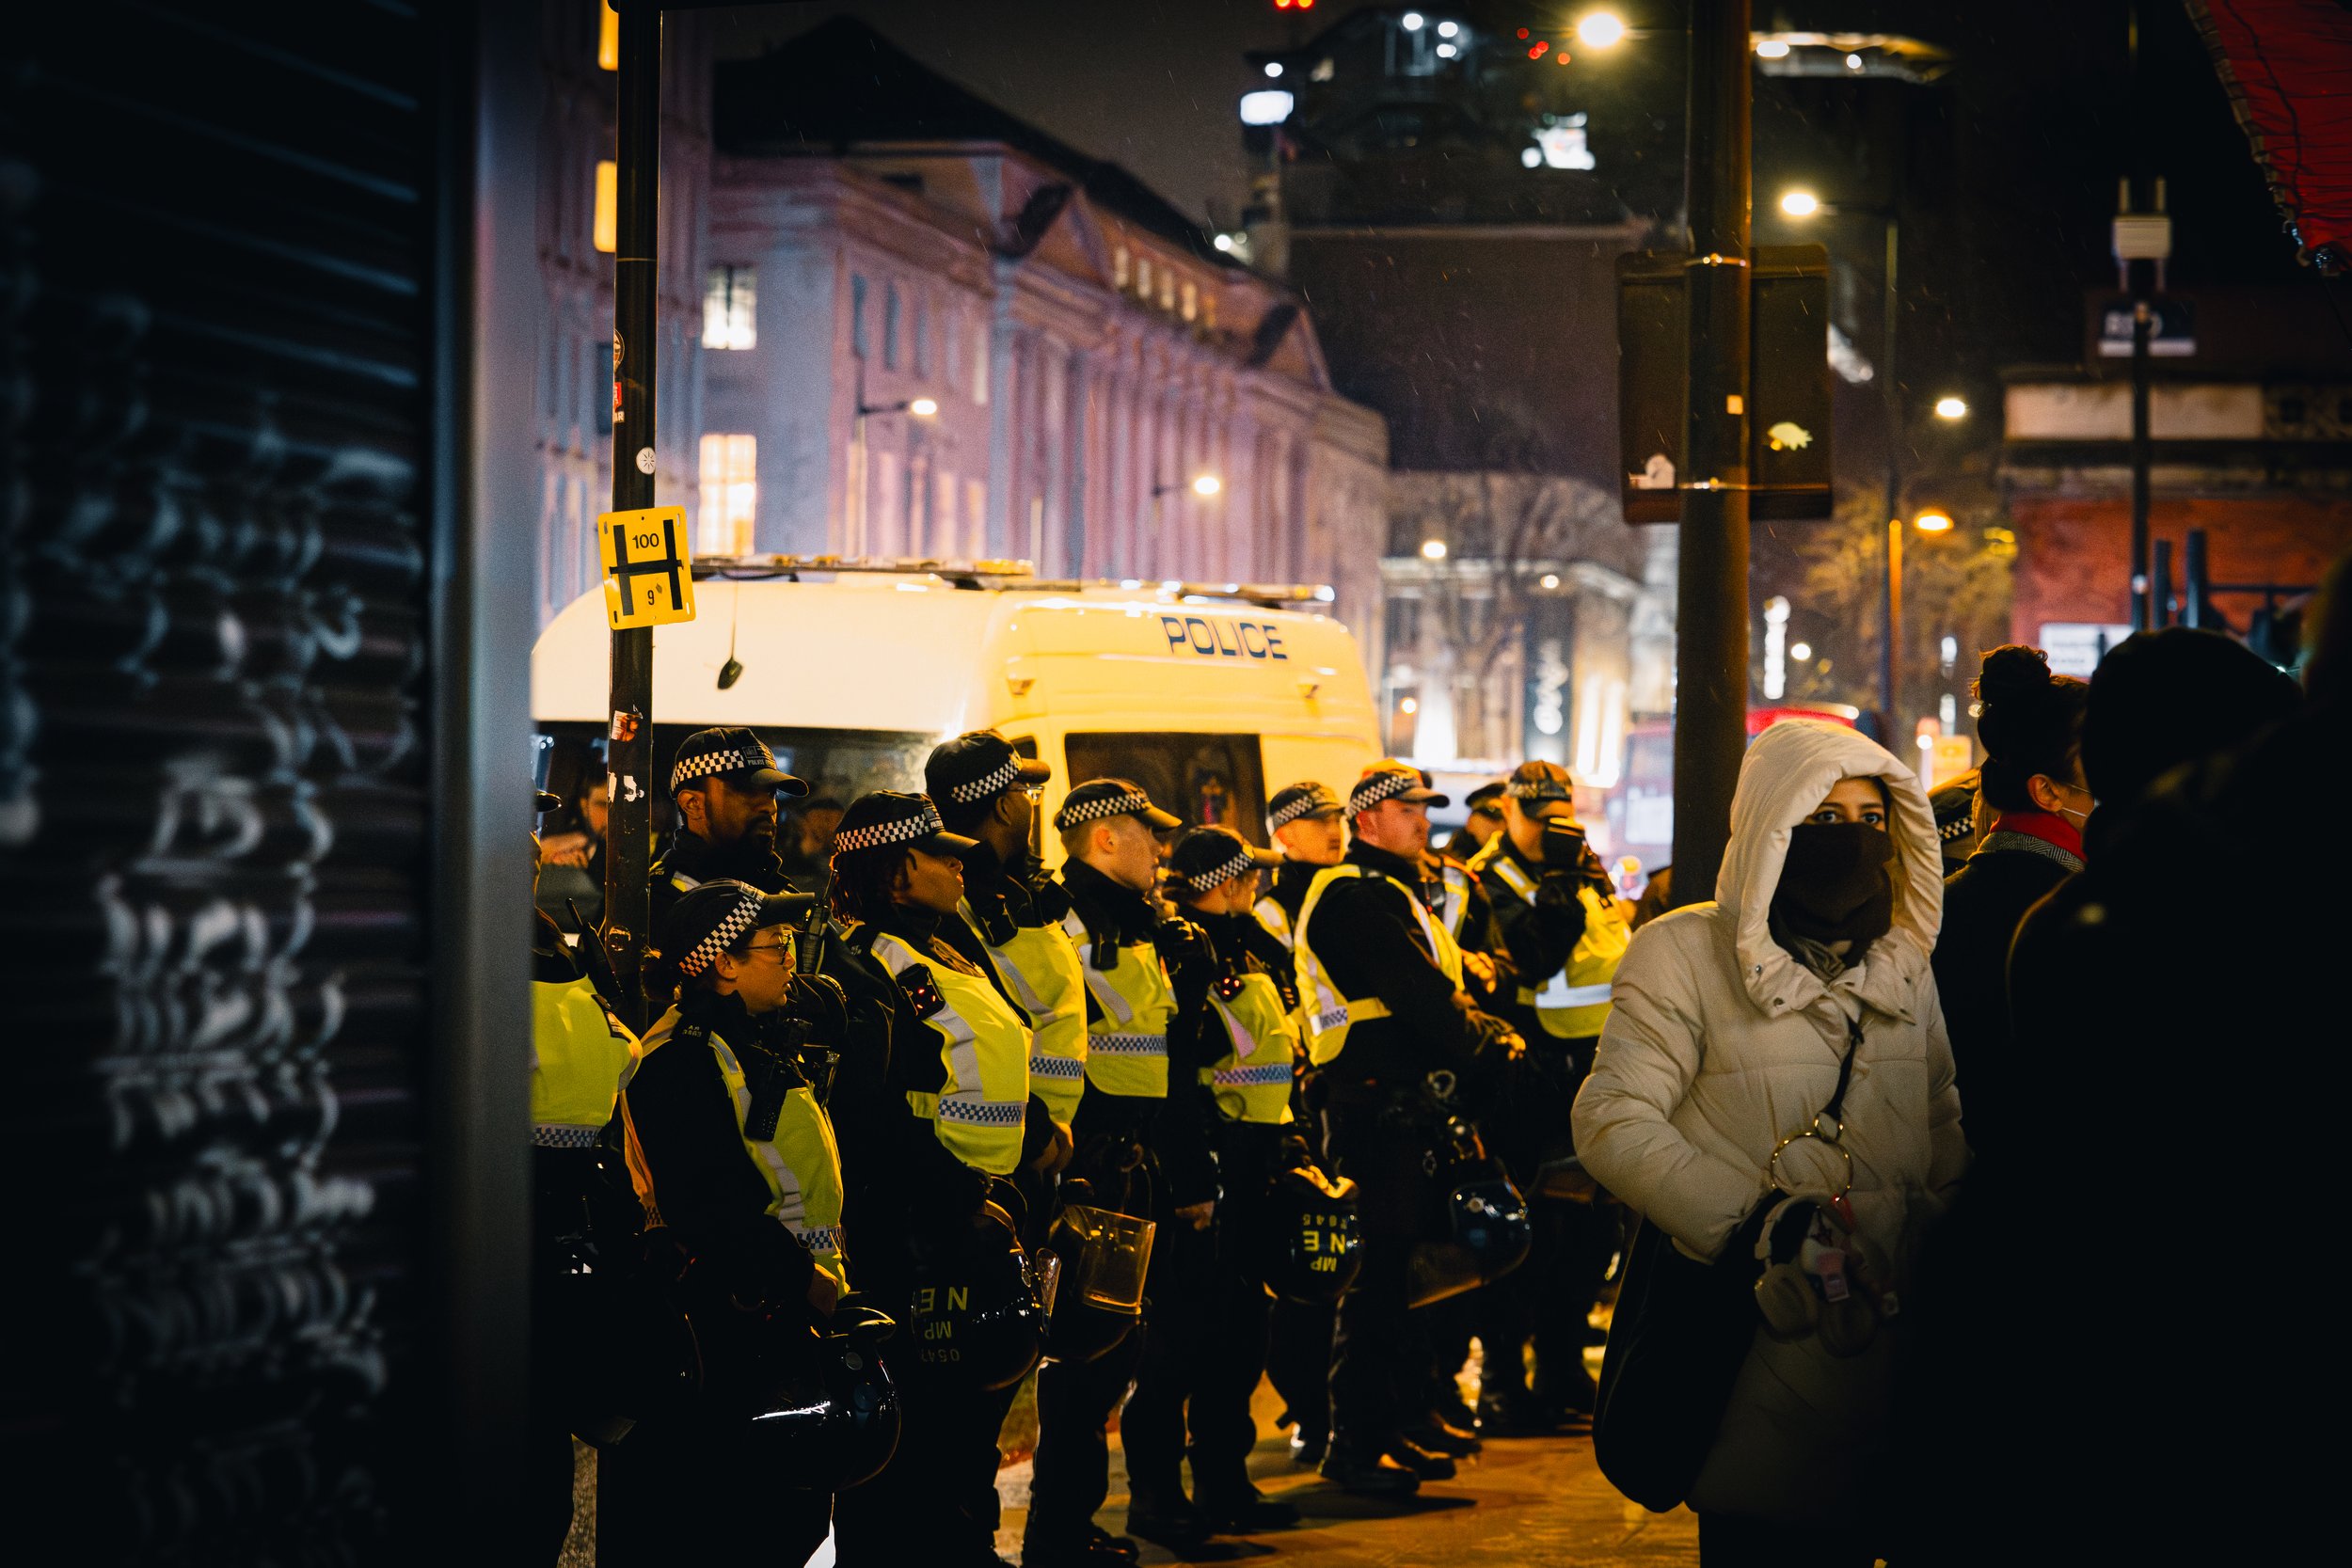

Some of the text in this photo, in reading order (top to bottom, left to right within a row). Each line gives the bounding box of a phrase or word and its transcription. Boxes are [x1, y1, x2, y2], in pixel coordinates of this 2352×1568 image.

[631, 532, 660, 549] 100
[647, 589, 656, 606] 9
[1160, 616, 1288, 659] POLICE
[1310, 1256, 1338, 1273] MP
[924, 1321, 953, 1340] MP
